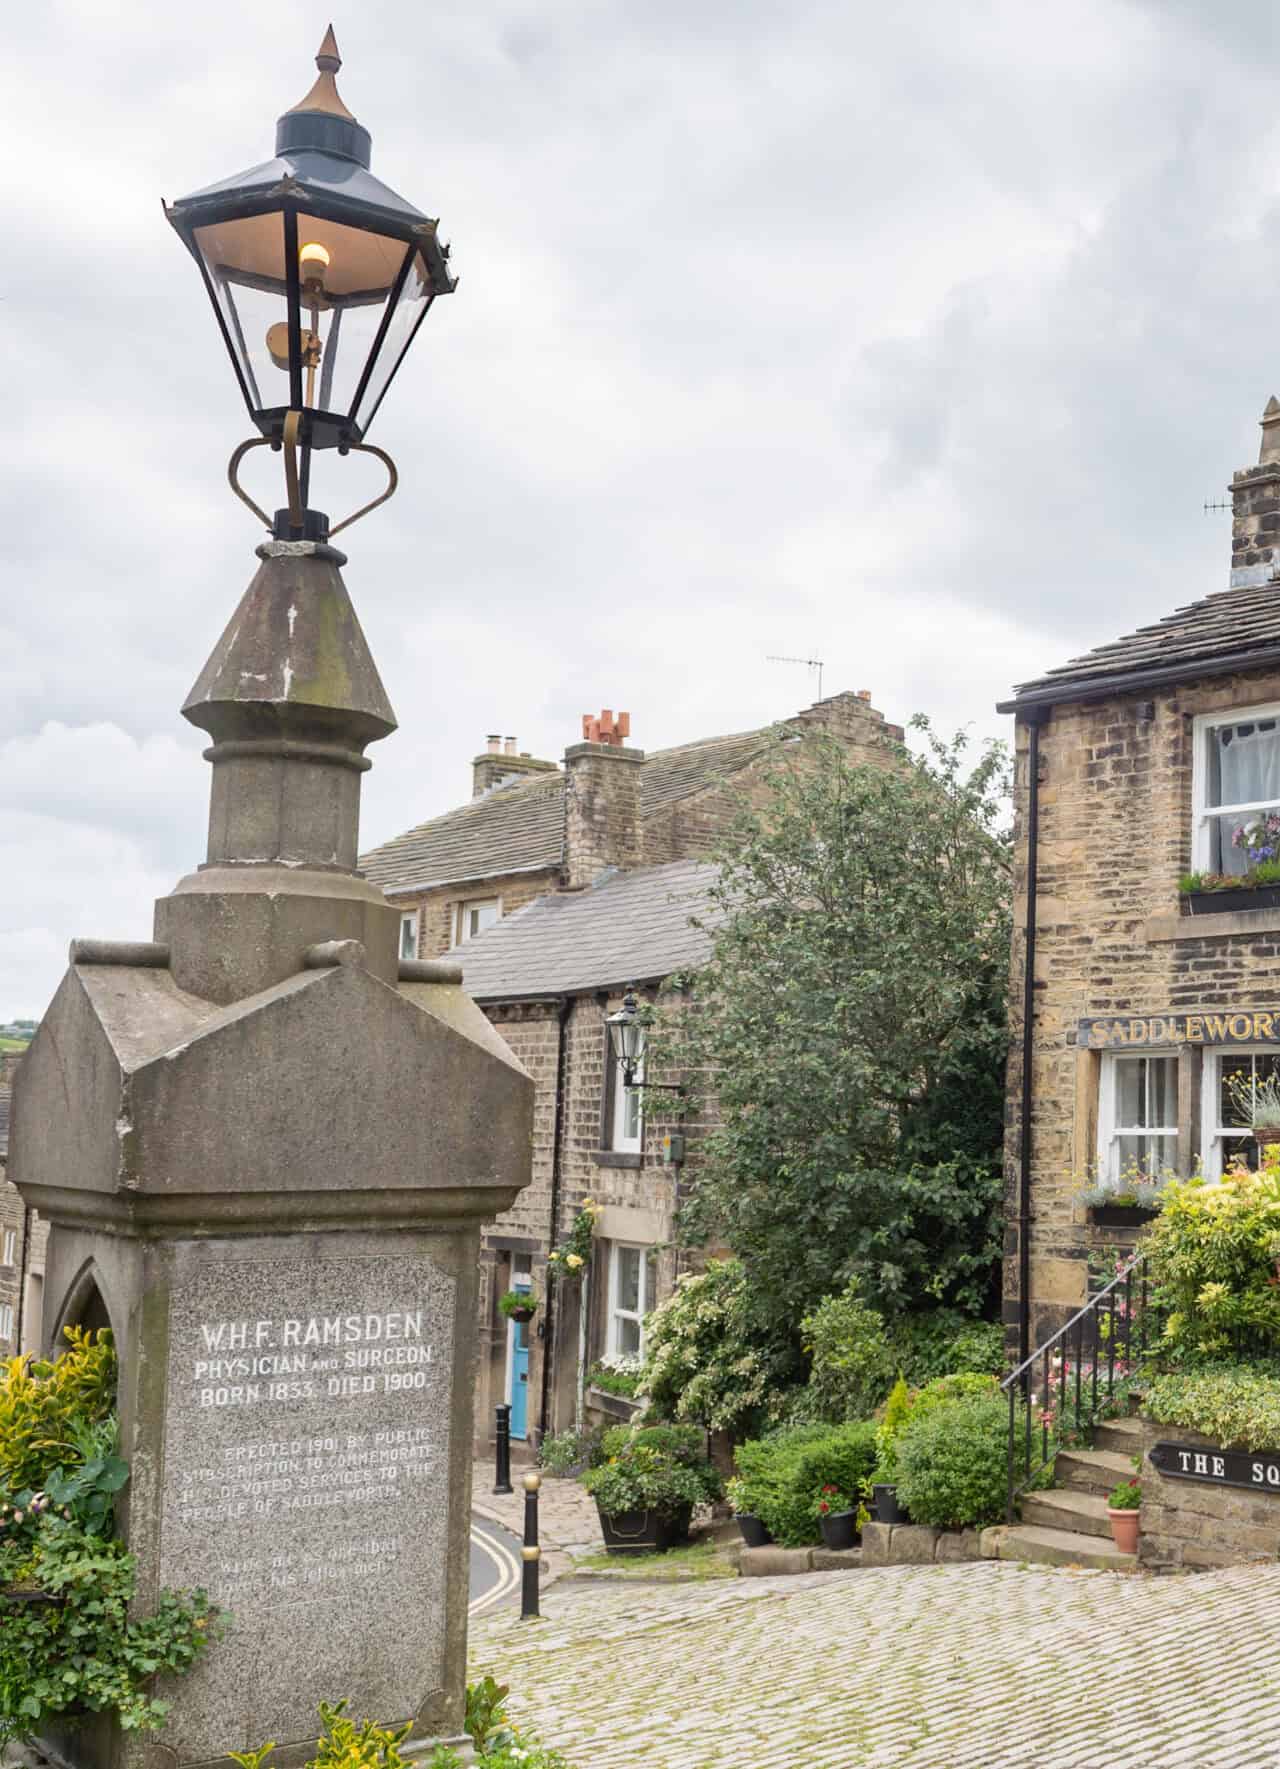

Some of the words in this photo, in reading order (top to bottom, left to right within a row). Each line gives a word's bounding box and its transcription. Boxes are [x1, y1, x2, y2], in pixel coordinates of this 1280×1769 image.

[201, 1320, 275, 1351] W.H.F.
[283, 1312, 422, 1346] RAMSDEN
[193, 1354, 307, 1379] PHYSICIAN
[311, 1358, 338, 1370] AND
[199, 1386, 259, 1408] BORN
[328, 1376, 375, 1396] DIED
[224, 1441, 301, 1461] ERECTED
[308, 1437, 338, 1453] 1901
[347, 1434, 368, 1449] BY
[376, 1427, 430, 1445] PUBLIC
[306, 1457, 322, 1470] TO
[330, 1444, 434, 1466] COMMEMORATE
[1178, 1451, 1225, 1477] THE
[221, 1478, 292, 1498] DEVOTED
[300, 1469, 372, 1489] SERVICES
[379, 1466, 396, 1479] TO
[405, 1461, 434, 1476] THE
[255, 1498, 275, 1513] OF
